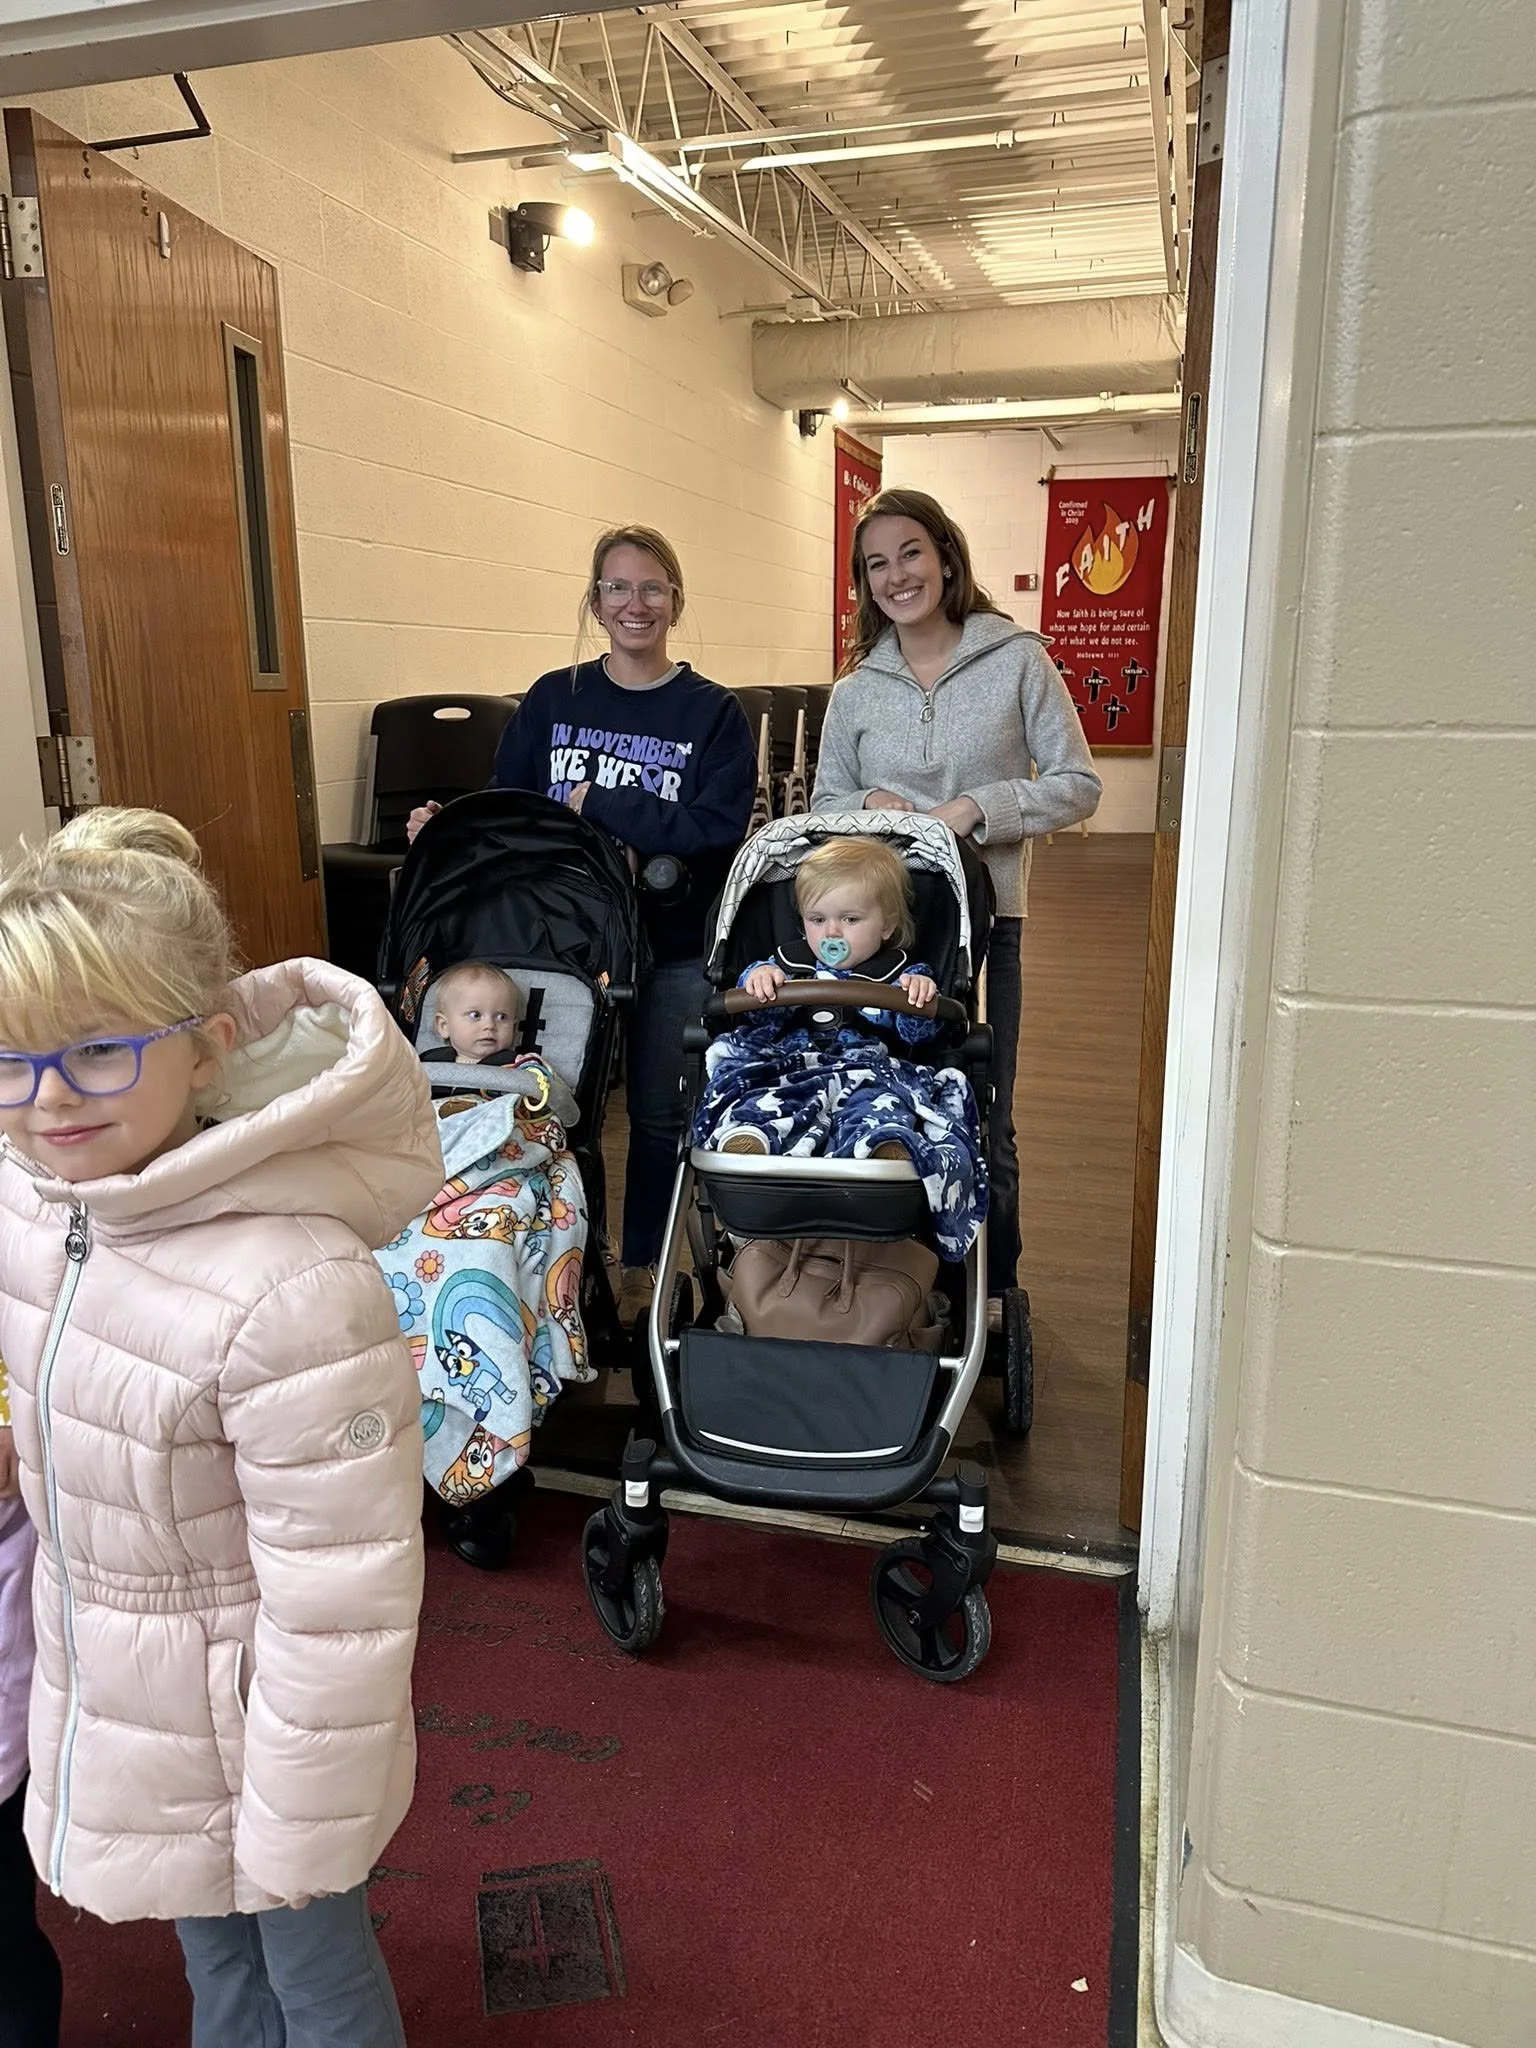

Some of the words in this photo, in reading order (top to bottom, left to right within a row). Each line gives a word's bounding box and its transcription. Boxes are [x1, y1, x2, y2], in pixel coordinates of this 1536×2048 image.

[1058, 500, 1088, 508] Confirmed
[1056, 498, 1155, 597] FAITH
[1056, 610, 1070, 618] Now
[1072, 609, 1088, 618] faith
[1090, 609, 1096, 618] is
[1098, 608, 1118, 620] being
[1136, 608, 1144, 616] of
[1049, 622, 1065, 632] what
[1067, 624, 1078, 632] we
[1080, 622, 1097, 634] hope
[1100, 622, 1110, 631] for
[1112, 622, 1125, 631] and
[1127, 621, 1150, 631] certain
[1060, 636, 1067, 645] of
[1070, 636, 1086, 645] what
[1101, 636, 1110, 645] do
[1111, 636, 1122, 645] not
[1124, 637, 1138, 645] see.
[551, 722, 572, 747] IN
[550, 748, 590, 784] WE
